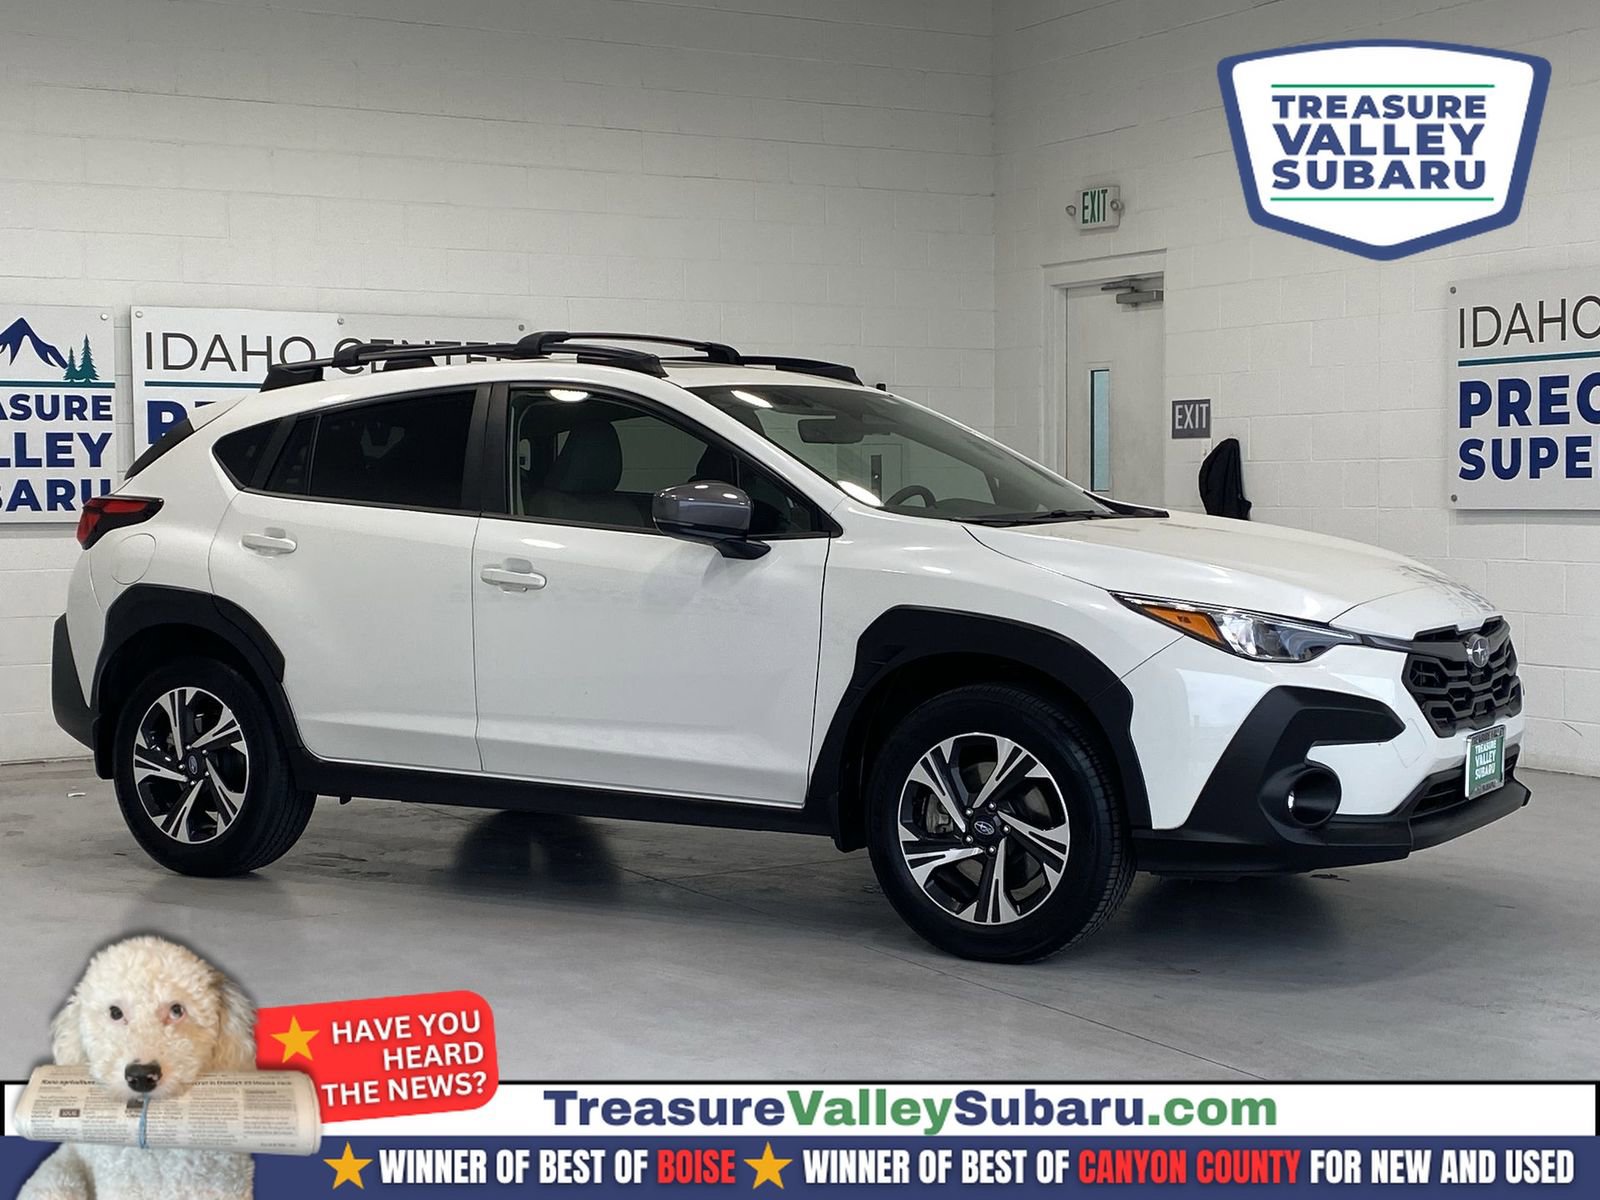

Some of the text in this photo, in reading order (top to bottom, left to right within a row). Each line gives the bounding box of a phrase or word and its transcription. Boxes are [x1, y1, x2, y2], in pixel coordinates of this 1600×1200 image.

[1082, 189, 1108, 224] EXIT
[1459, 296, 1600, 349] IDAHO
[145, 331, 317, 373] IDAHO
[0, 393, 113, 421] SURE
[1175, 403, 1209, 430] EXIT
[1459, 436, 1593, 481] SUPE
[0, 478, 111, 512] ARU
[1474, 739, 1497, 755] TREASURE
[1474, 749, 1497, 768] VALLEY
[1474, 762, 1496, 780] SUBARU
